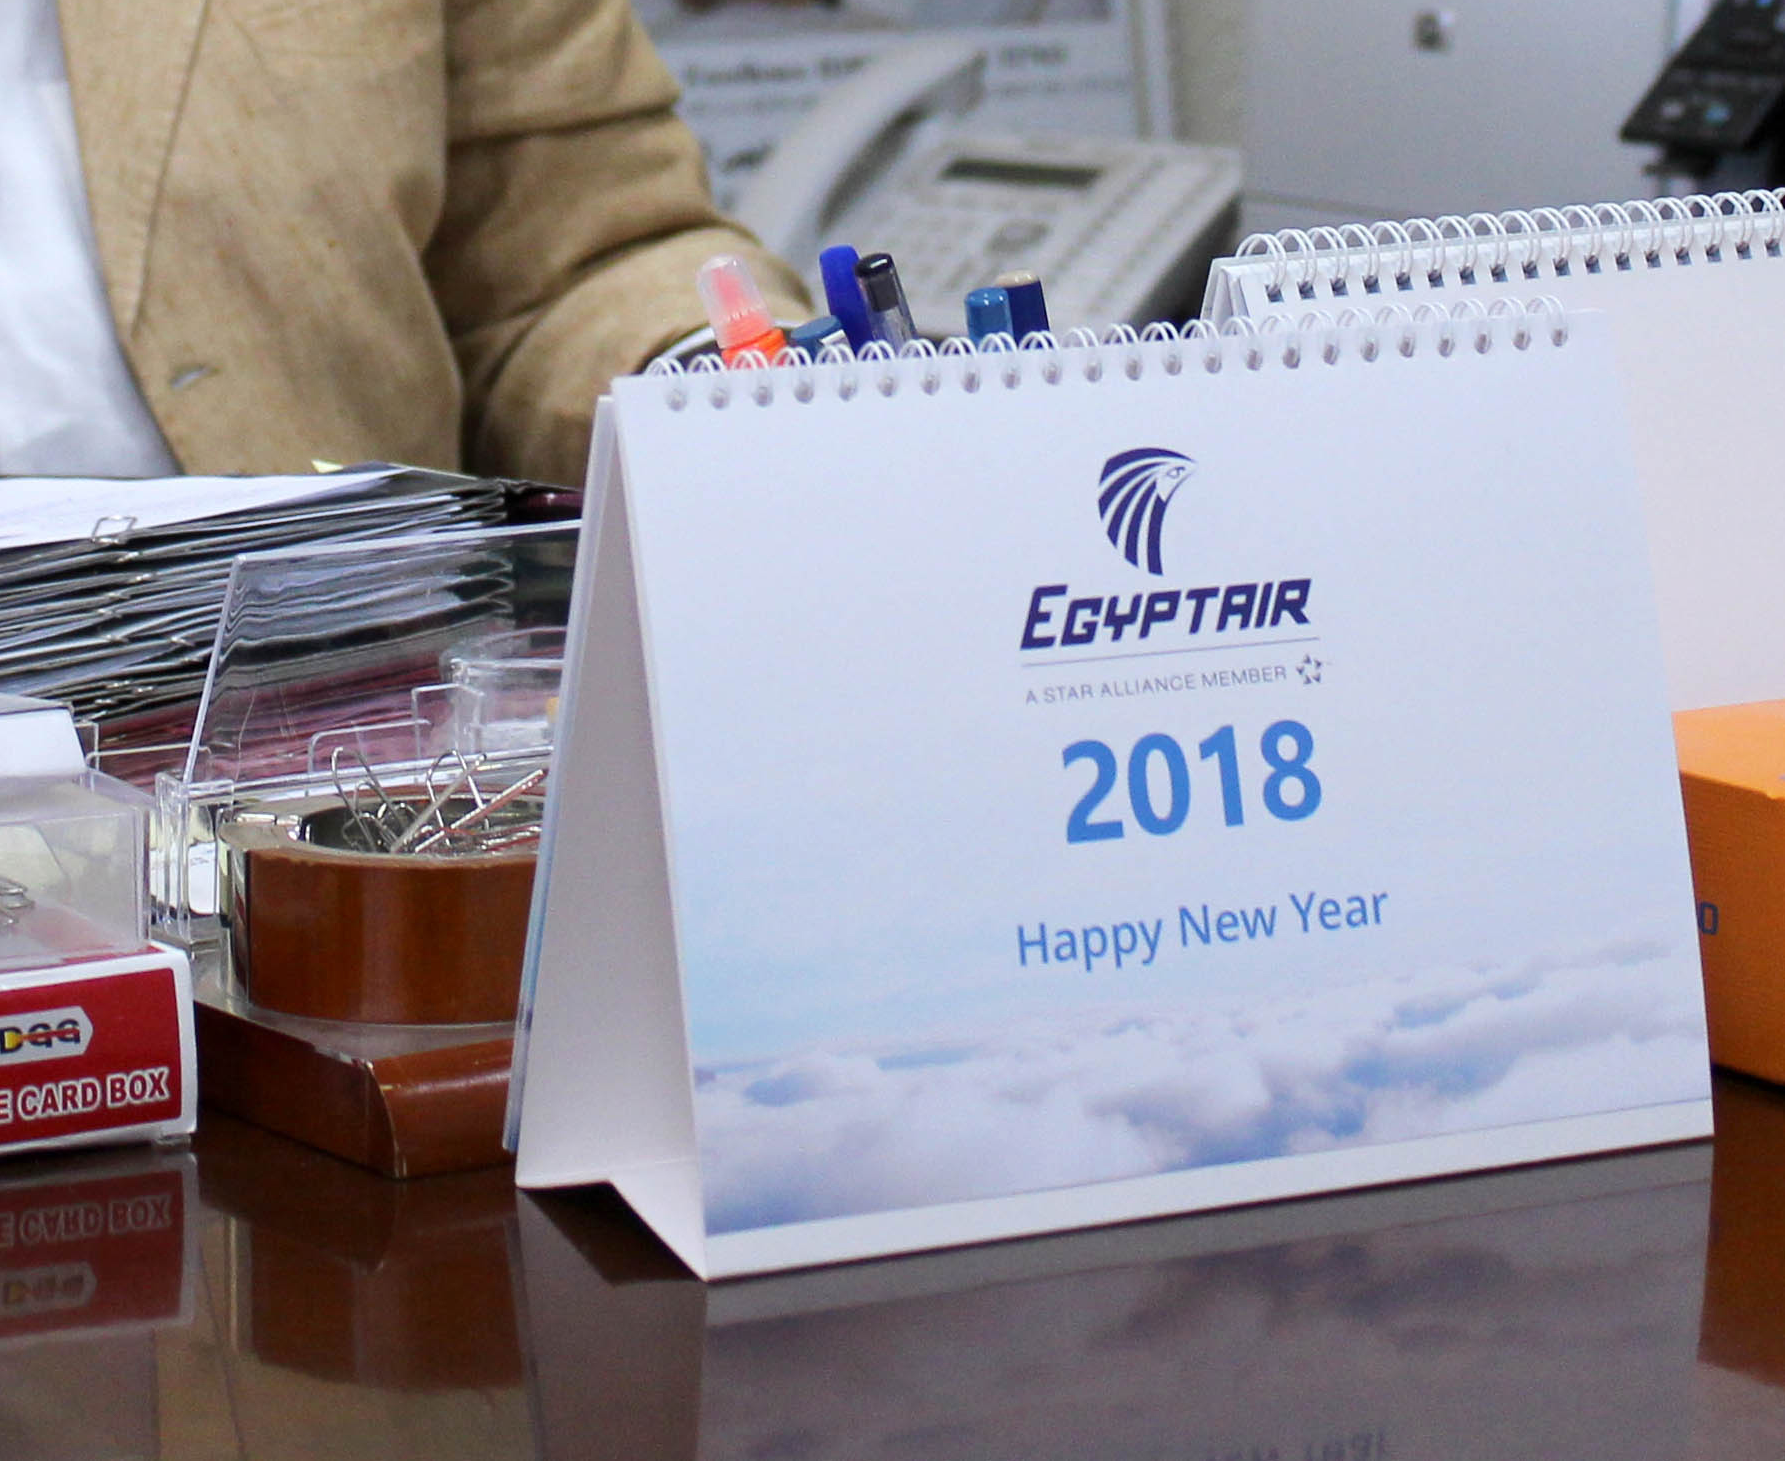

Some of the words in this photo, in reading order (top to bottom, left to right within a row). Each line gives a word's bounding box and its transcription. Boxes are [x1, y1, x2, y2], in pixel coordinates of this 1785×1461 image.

[1020, 578, 1313, 651] EGYPTAIR
[1025, 688, 1039, 704] A
[1043, 683, 1094, 702] STAR
[1100, 672, 1197, 698] ALLIANCE
[1201, 664, 1287, 688] MEMBER
[1061, 719, 1323, 844] 2018
[1017, 917, 1162, 972] Happy
[1178, 901, 1277, 948] New
[1288, 889, 1389, 934] Year
[18, 1080, 102, 1120] CARD
[107, 1067, 169, 1106] BOX
